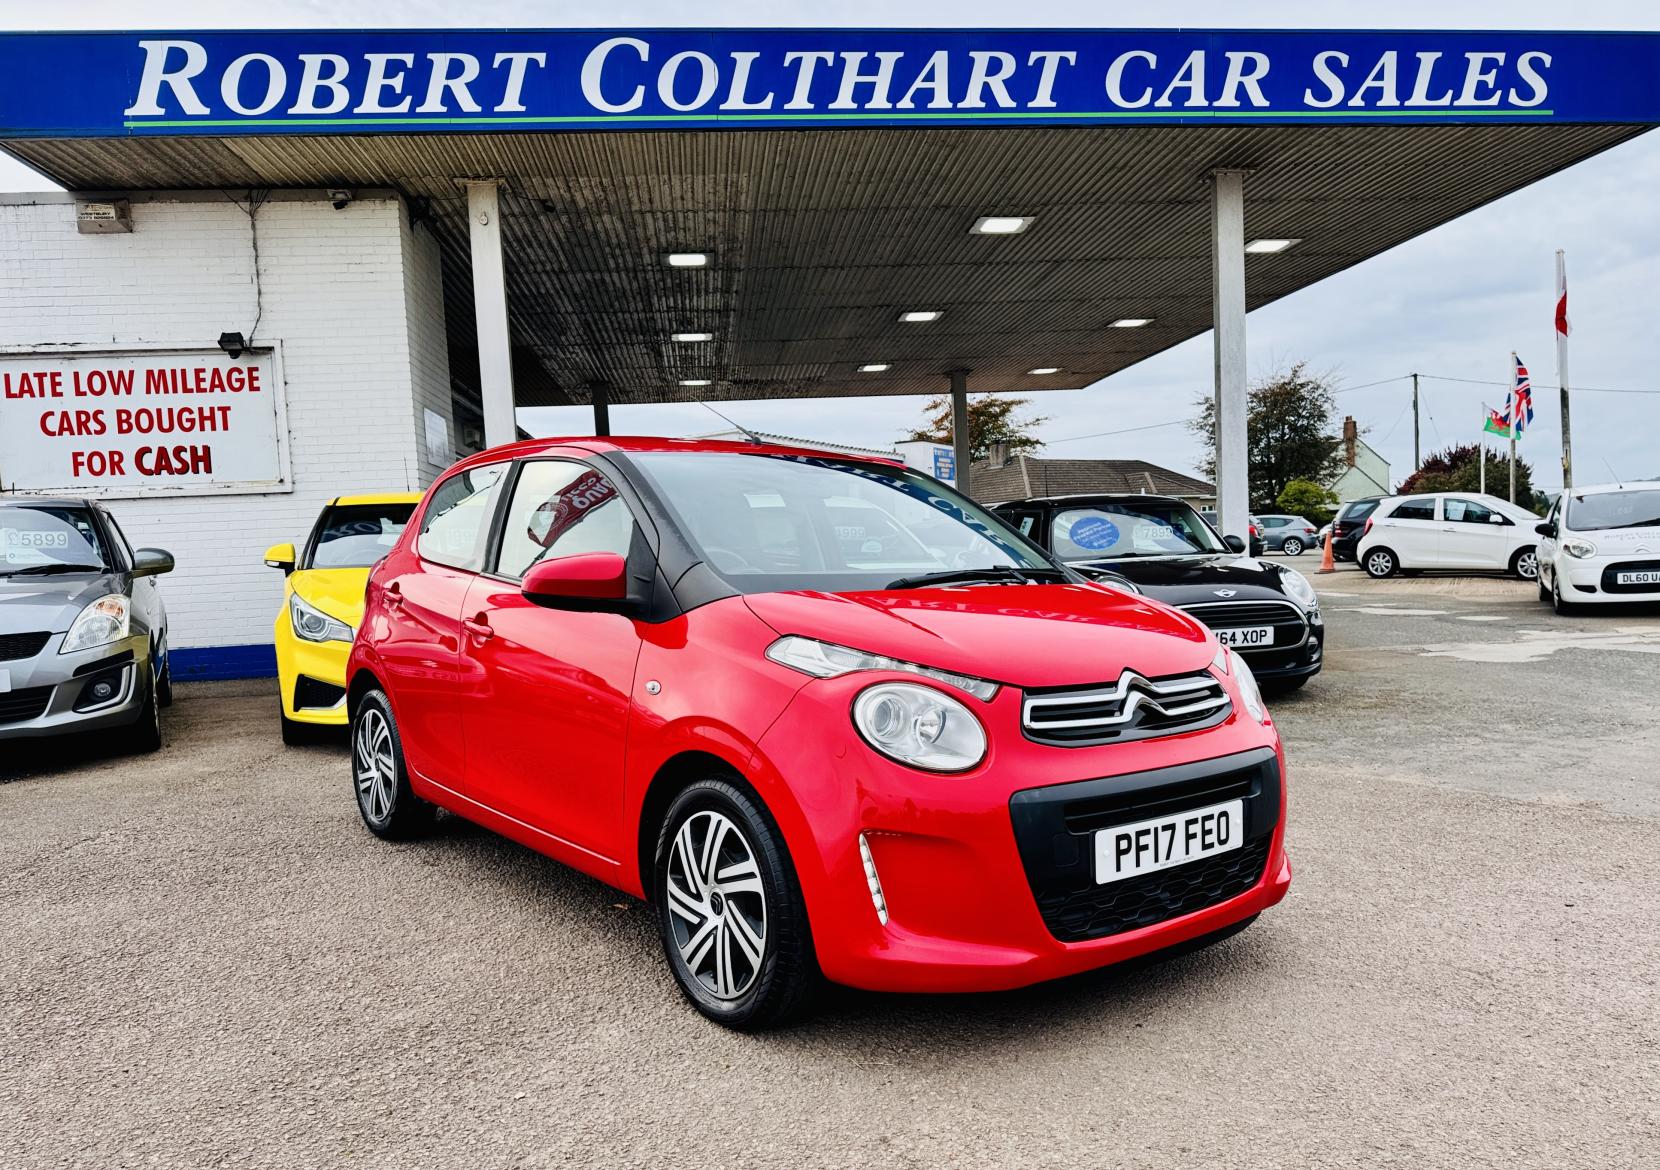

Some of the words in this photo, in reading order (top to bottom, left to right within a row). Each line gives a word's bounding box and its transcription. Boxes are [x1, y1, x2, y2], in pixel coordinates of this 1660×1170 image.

[124, 40, 547, 116] ROBERT
[580, 37, 1077, 113] COLTHART
[1105, 50, 1270, 109] CAR
[1303, 50, 1552, 108] SALES
[4, 371, 64, 399] LATE
[73, 369, 135, 397] LOW
[145, 366, 261, 395] MILEAGE
[40, 409, 107, 437] CARS
[116, 405, 231, 435] BOUGHT
[71, 450, 125, 477] FOR
[134, 445, 213, 476] CASH
[8, 532, 67, 546] £5899
[1622, 574, 1649, 583] DL60
[1241, 629, 1268, 644] XOP
[1115, 822, 1177, 873] PF17
[1185, 810, 1230, 856] FEO
